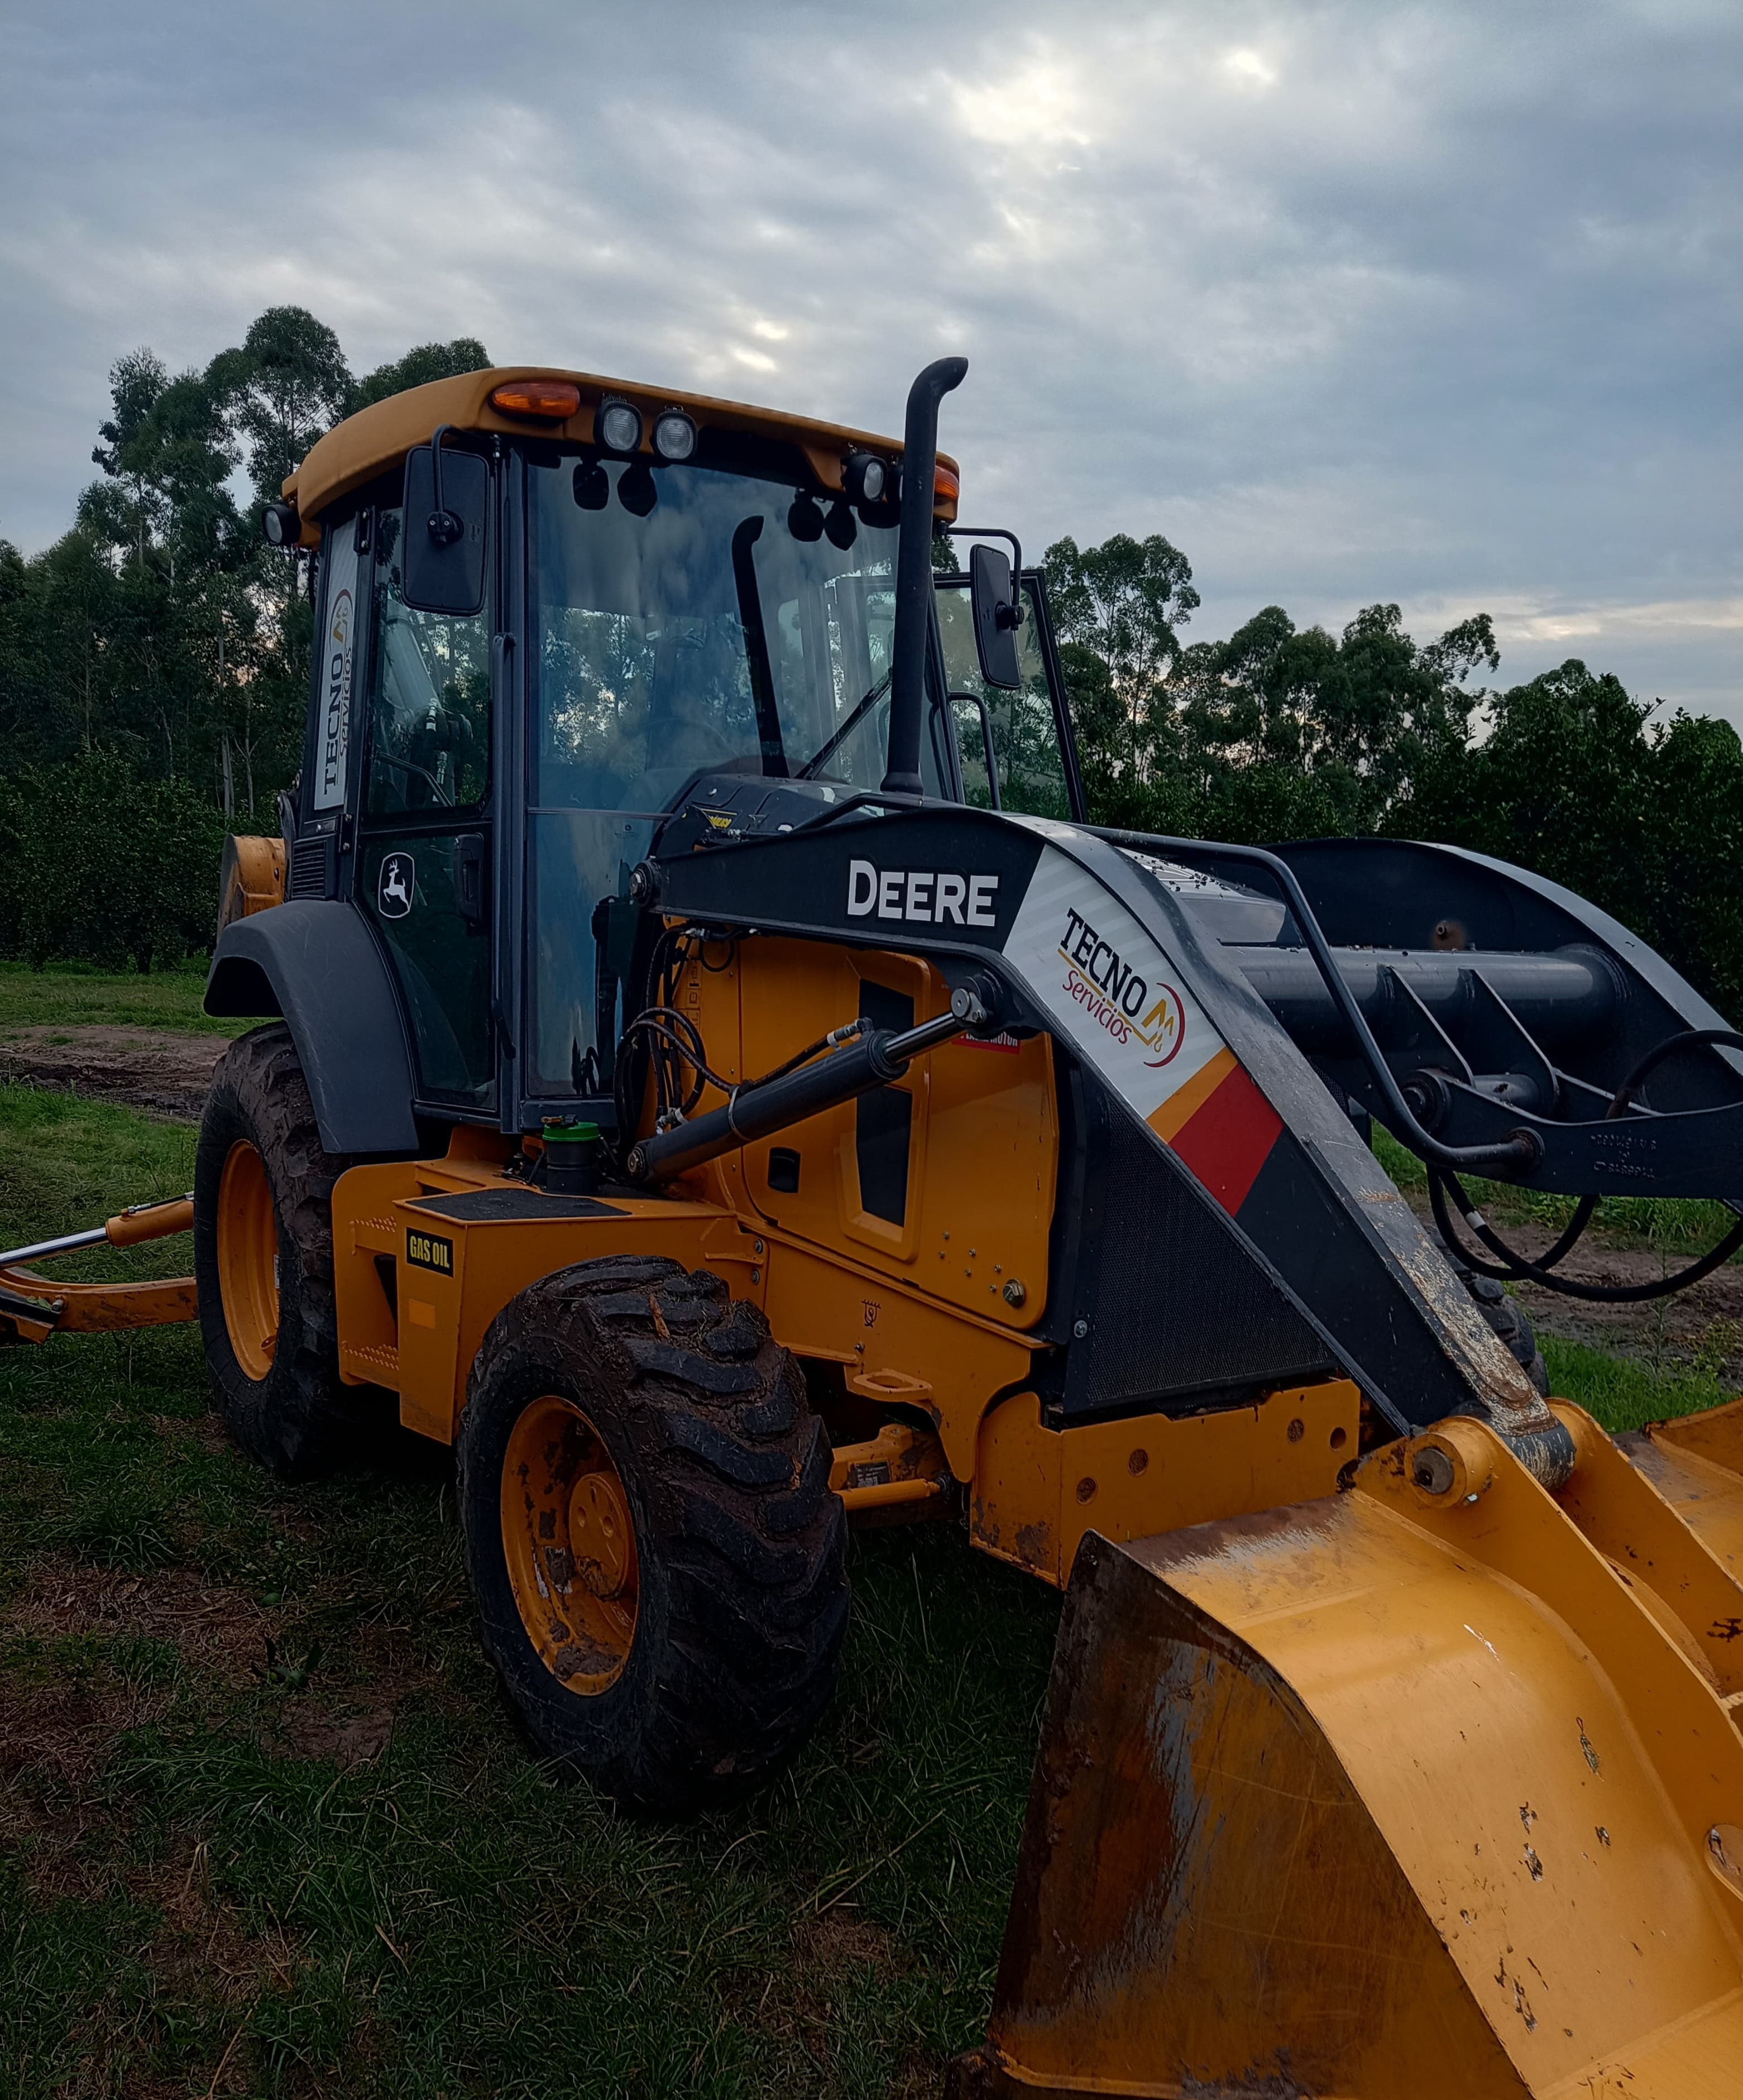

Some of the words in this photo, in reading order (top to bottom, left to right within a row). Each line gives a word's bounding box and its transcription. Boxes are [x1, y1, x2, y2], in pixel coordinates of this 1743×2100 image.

[324, 653, 343, 795] TECNO
[339, 647, 352, 757] Servicios
[847, 860, 998, 927] DEERE
[1060, 907, 1147, 1017] TECNO
[1062, 970, 1132, 1044] Servicios
[410, 1236, 430, 1262] GAS
[432, 1242, 450, 1269] OIL
